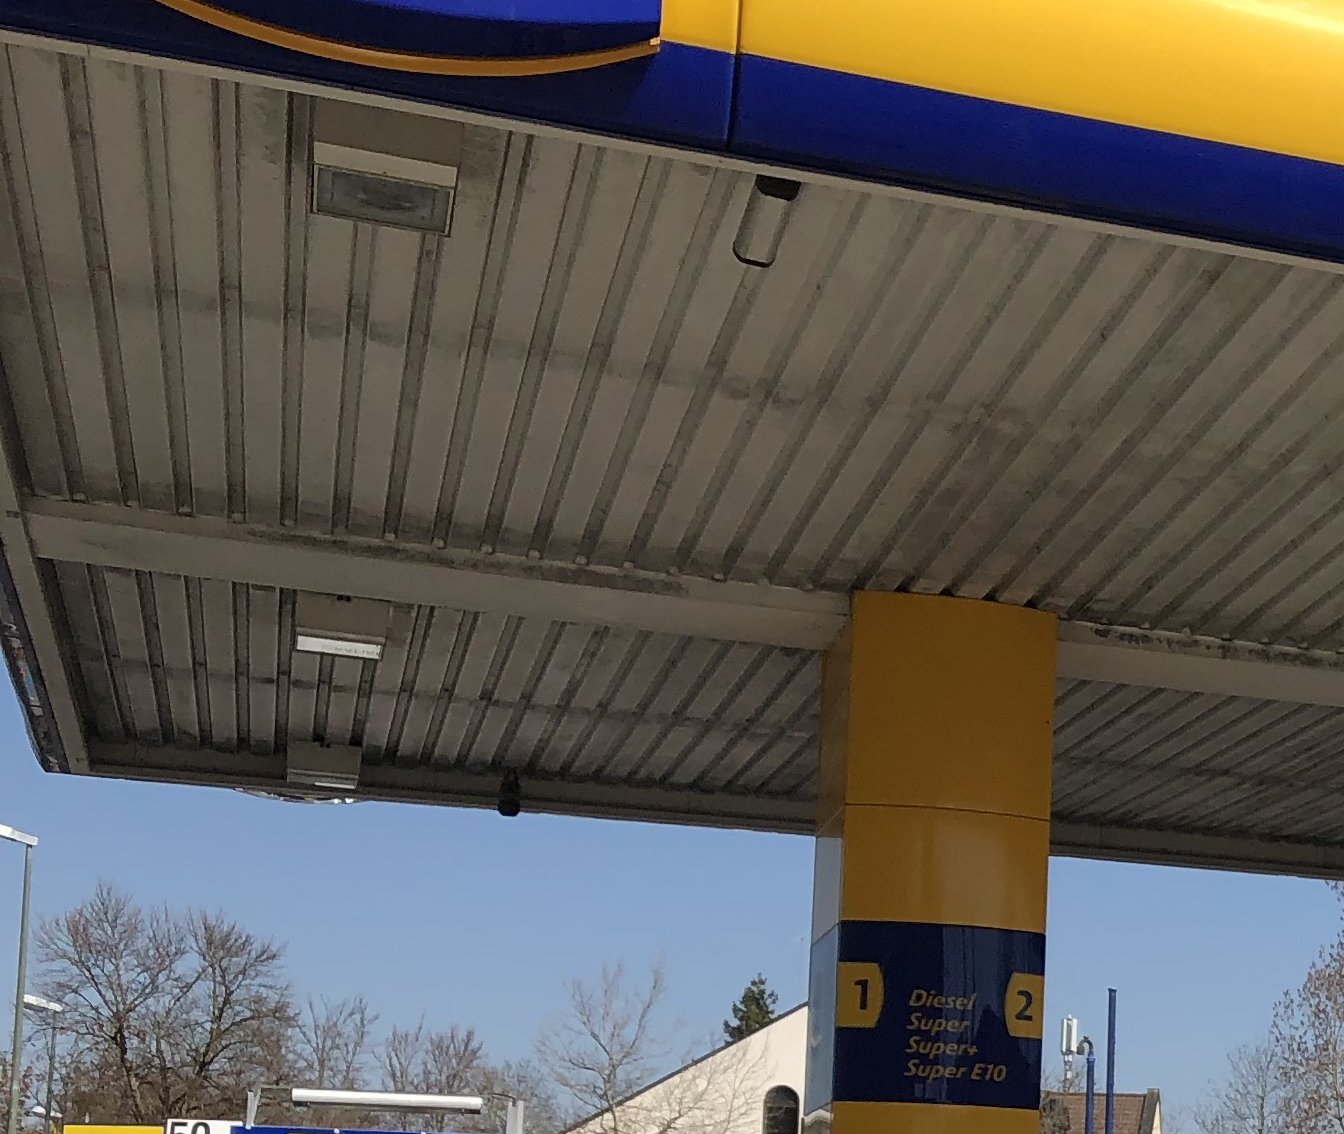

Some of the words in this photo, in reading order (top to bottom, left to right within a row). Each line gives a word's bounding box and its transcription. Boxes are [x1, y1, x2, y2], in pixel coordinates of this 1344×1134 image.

[854, 979, 868, 1010] 1
[909, 989, 976, 1010] Diesel
[1015, 990, 1033, 1021] 2
[906, 1013, 970, 1035] Super
[905, 1036, 979, 1059] Super+
[904, 1059, 967, 1082] Super
[971, 1063, 1007, 1082] E10
